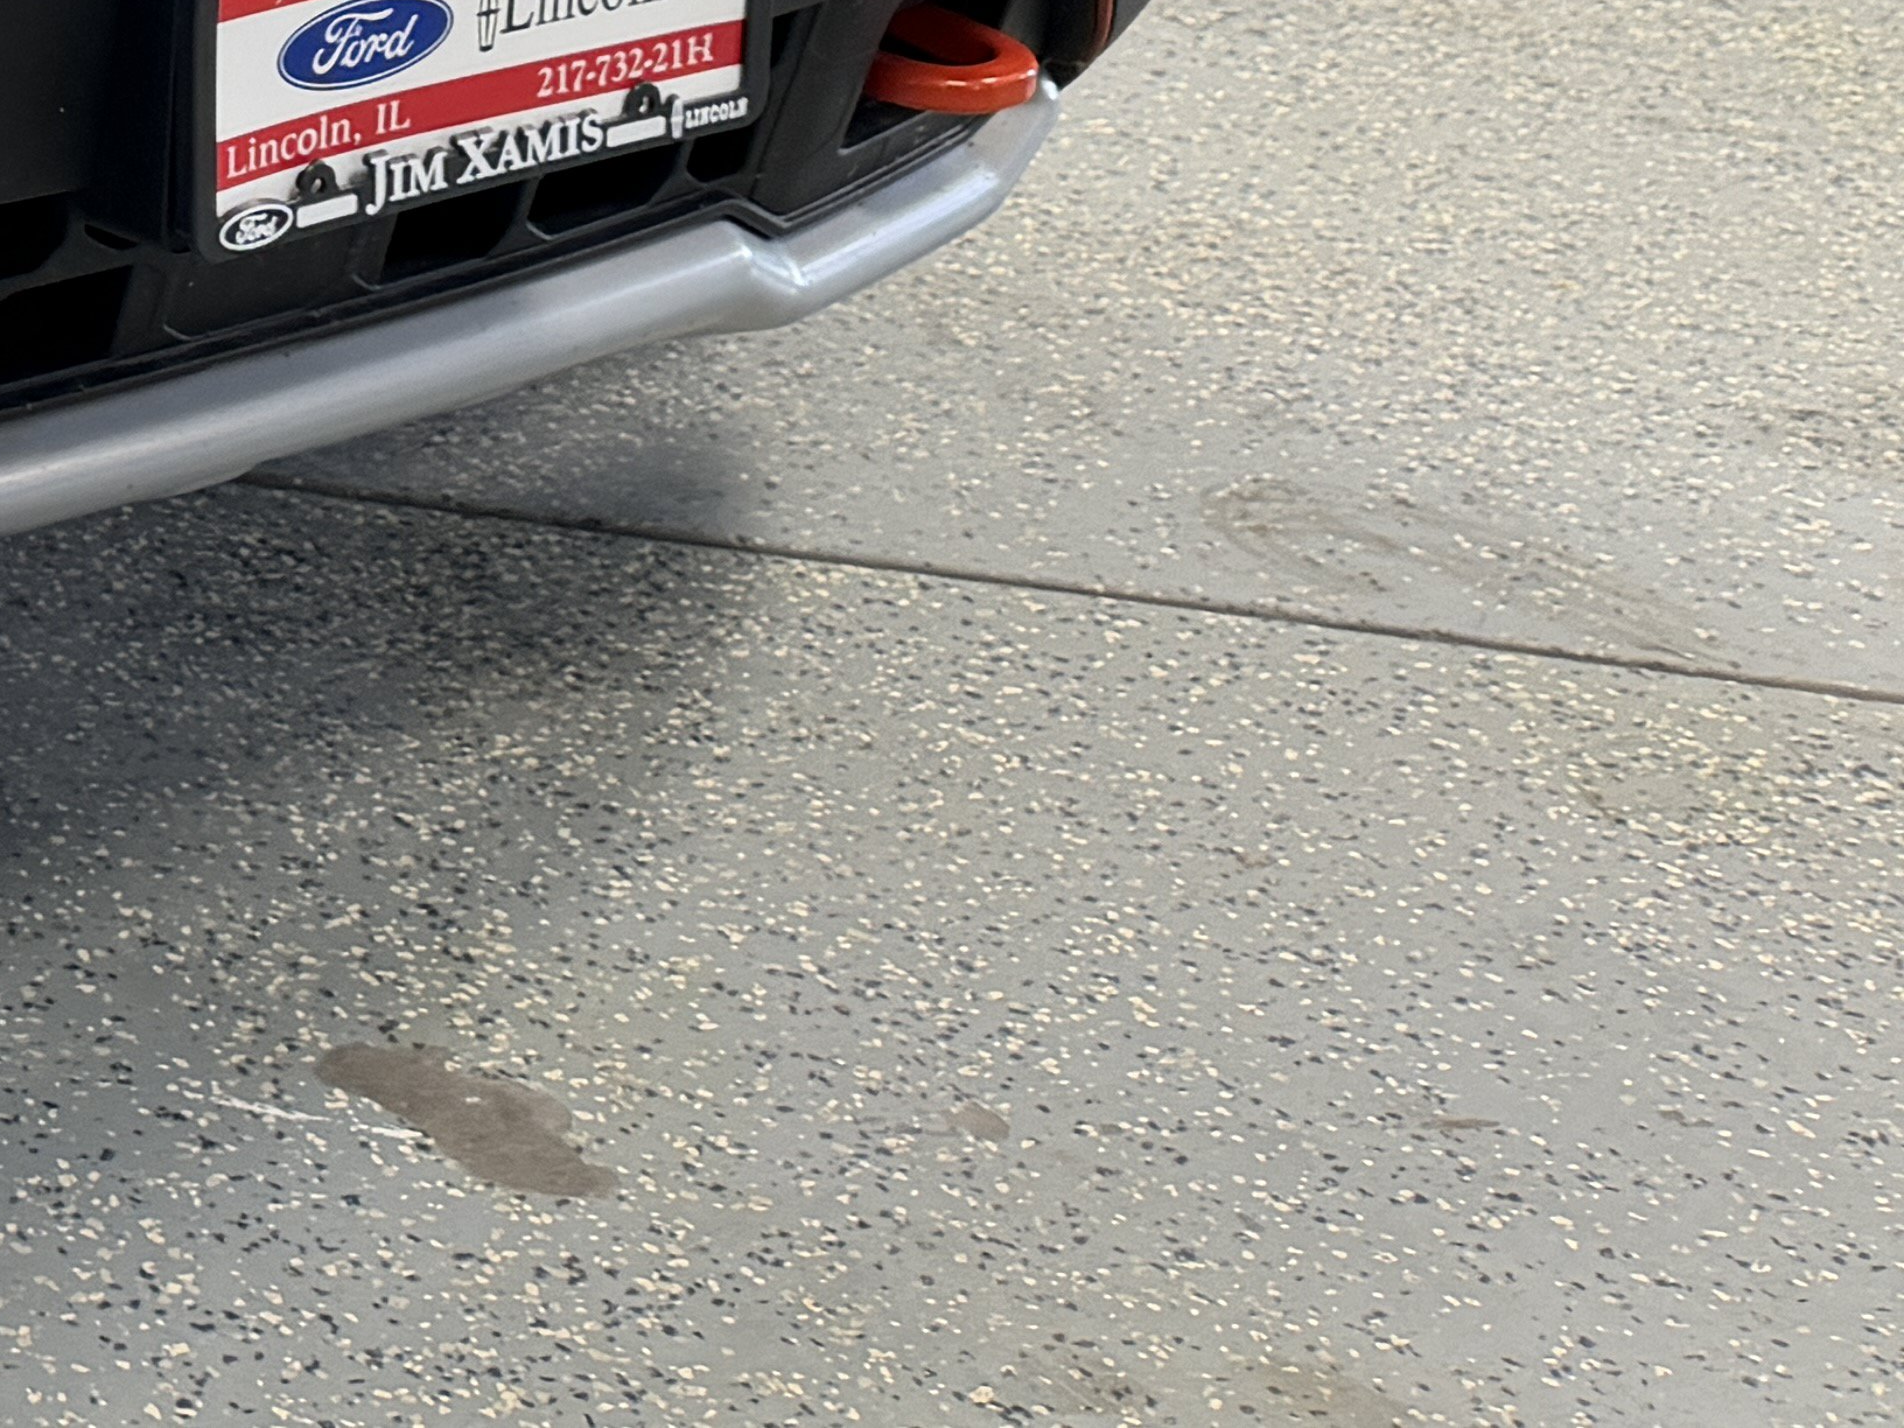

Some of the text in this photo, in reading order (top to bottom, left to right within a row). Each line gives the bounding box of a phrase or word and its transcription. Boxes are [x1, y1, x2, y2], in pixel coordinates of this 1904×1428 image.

[312, 10, 421, 75] Ford
[226, 99, 411, 179] Lincoln, IL
[364, 117, 605, 216] JIM XAMIS
[235, 213, 280, 246] Ford
